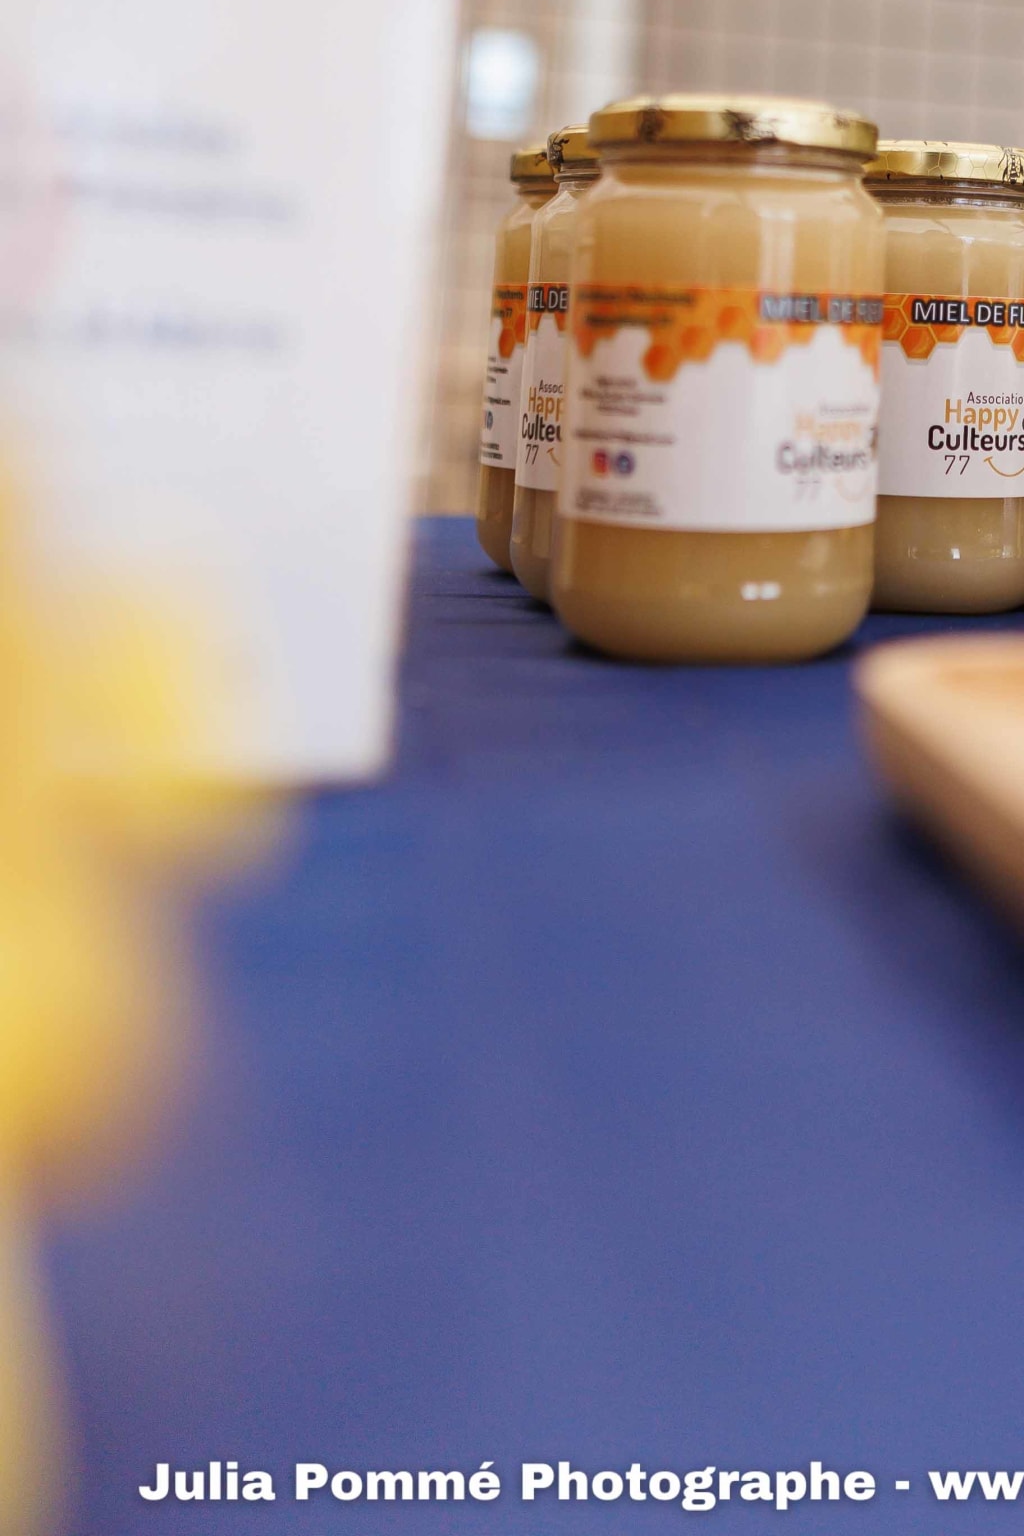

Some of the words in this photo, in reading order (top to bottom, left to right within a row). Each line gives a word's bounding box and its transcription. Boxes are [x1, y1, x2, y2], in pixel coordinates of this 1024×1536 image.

[548, 290, 568, 311] DE
[762, 296, 820, 322] MIEL
[914, 301, 970, 324] MIEL
[976, 303, 1004, 325] DE
[944, 398, 1020, 433] Happy
[525, 443, 540, 466] 77
[944, 454, 971, 476] 77
